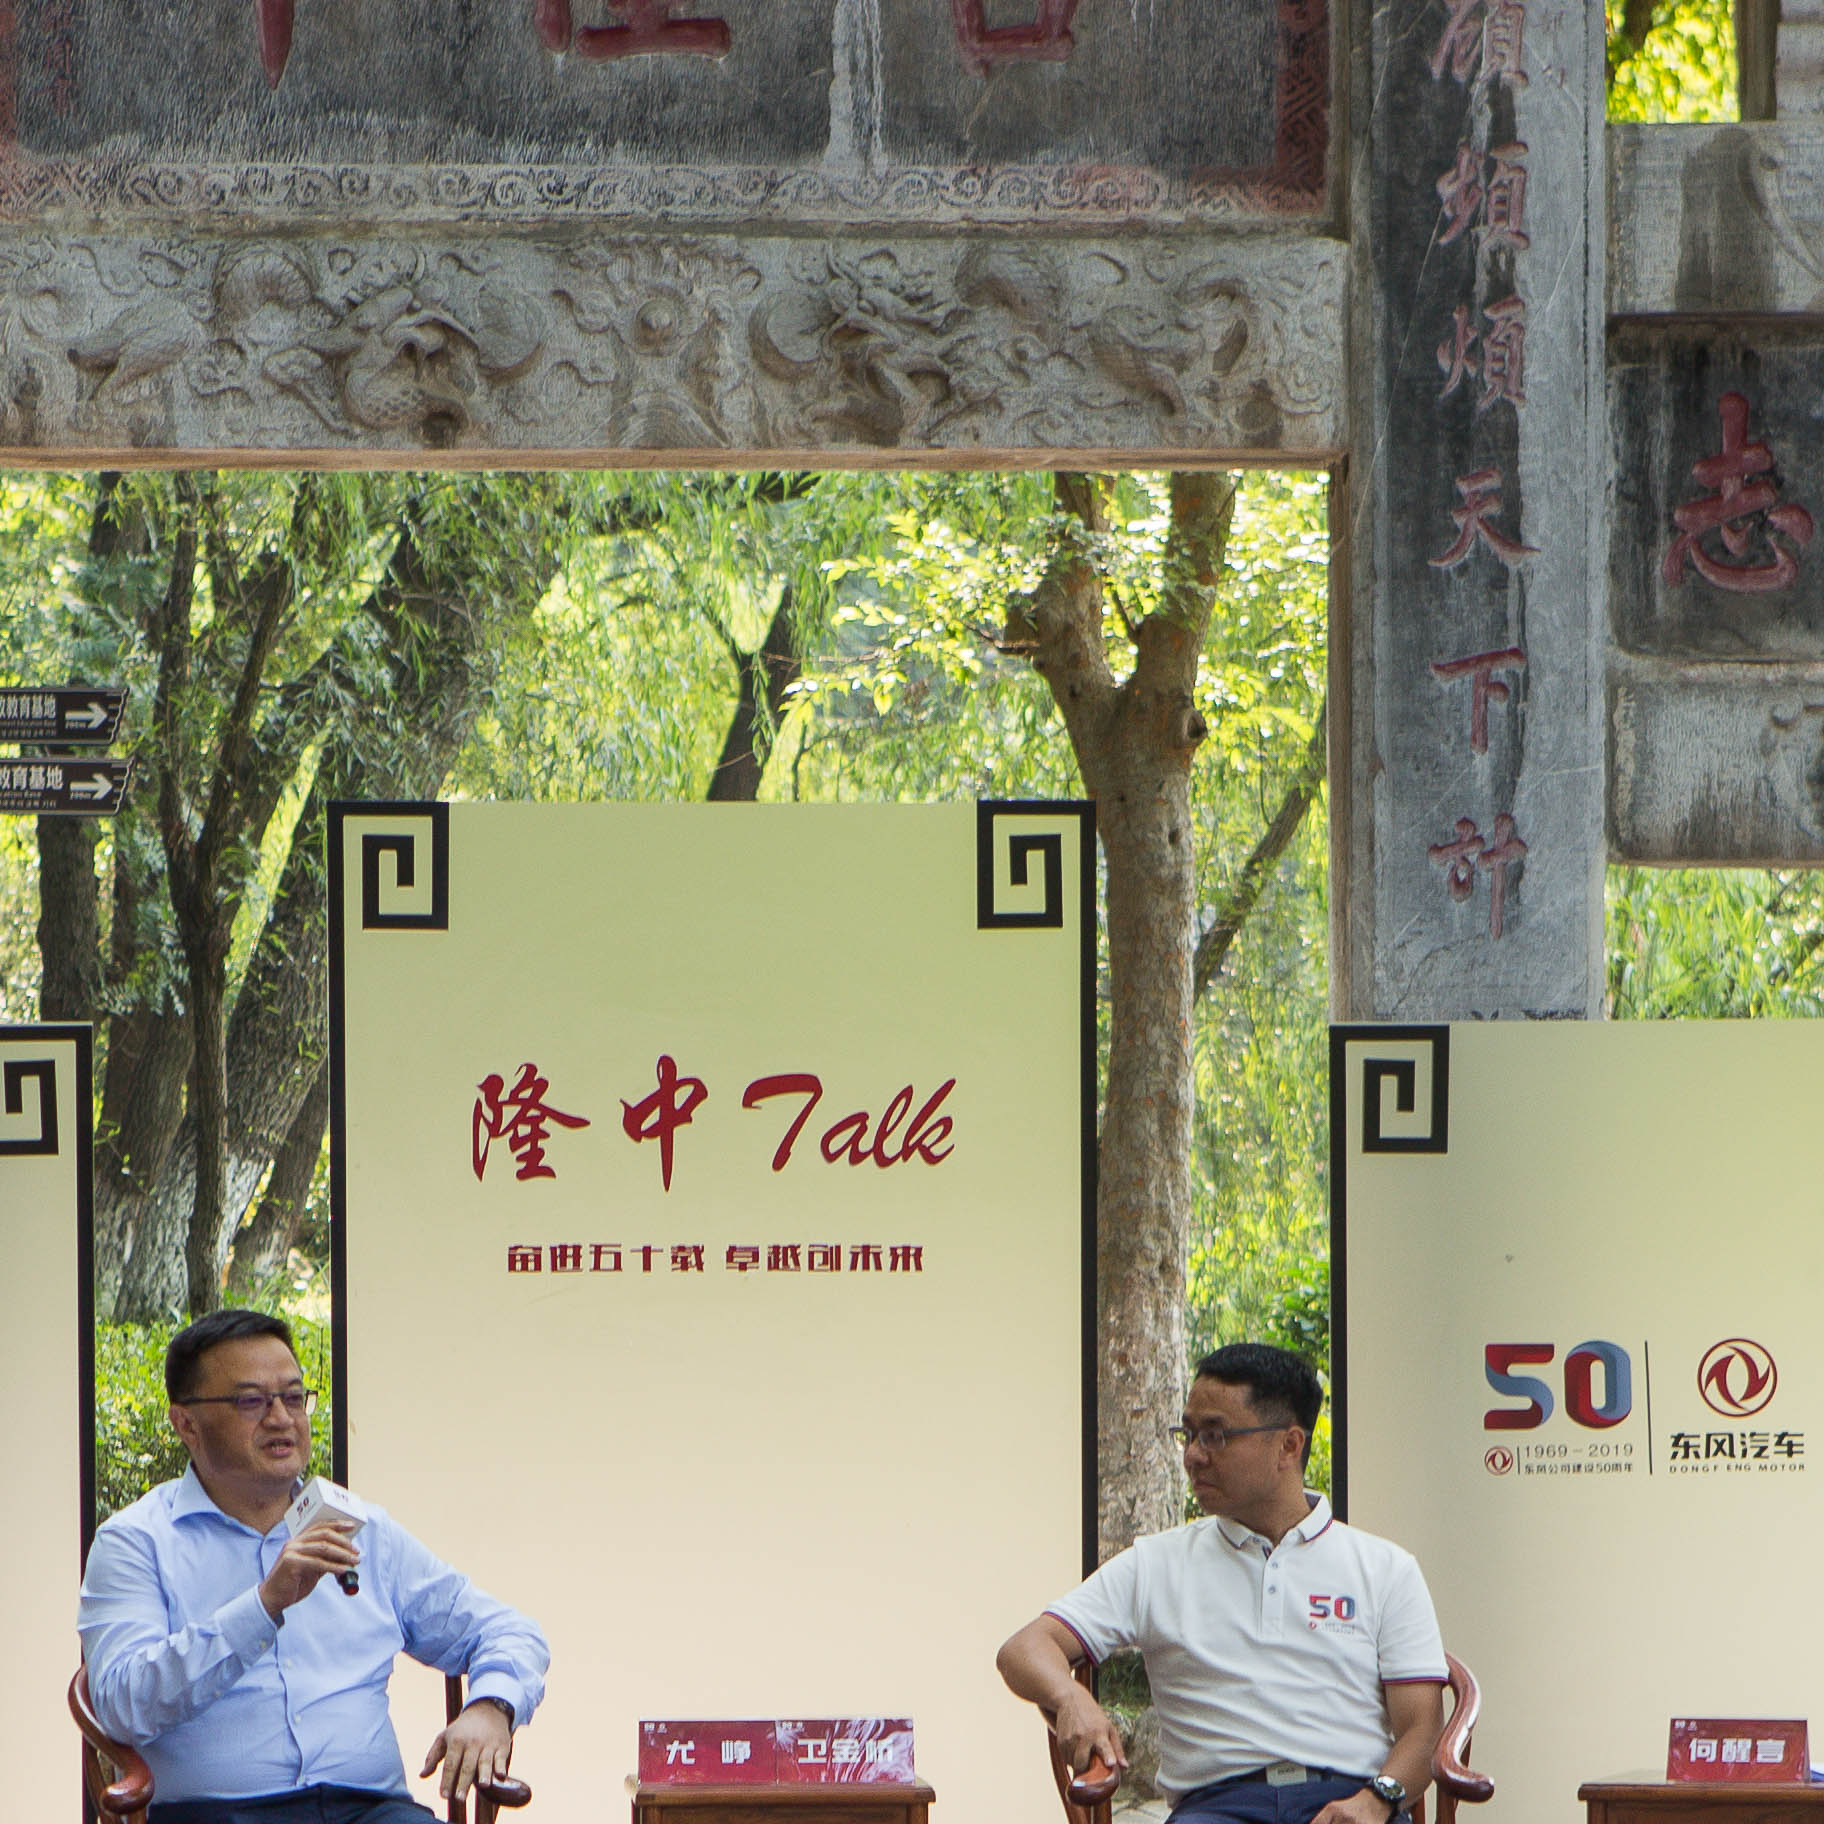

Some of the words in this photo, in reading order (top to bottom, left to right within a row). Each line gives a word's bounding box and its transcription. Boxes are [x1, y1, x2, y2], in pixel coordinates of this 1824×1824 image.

[473, 1055, 709, 1192] 隆中
[742, 1073, 957, 1172] Talk
[508, 1244, 704, 1273] 奋进五十载
[726, 1244, 924, 1273] 卓越创未来
[1484, 1340, 1632, 1430] 50
[1670, 1431, 1804, 1459] 东风汽车
[1758, 1463, 1805, 1473] MOTOR
[1308, 1594, 1356, 1621] 50
